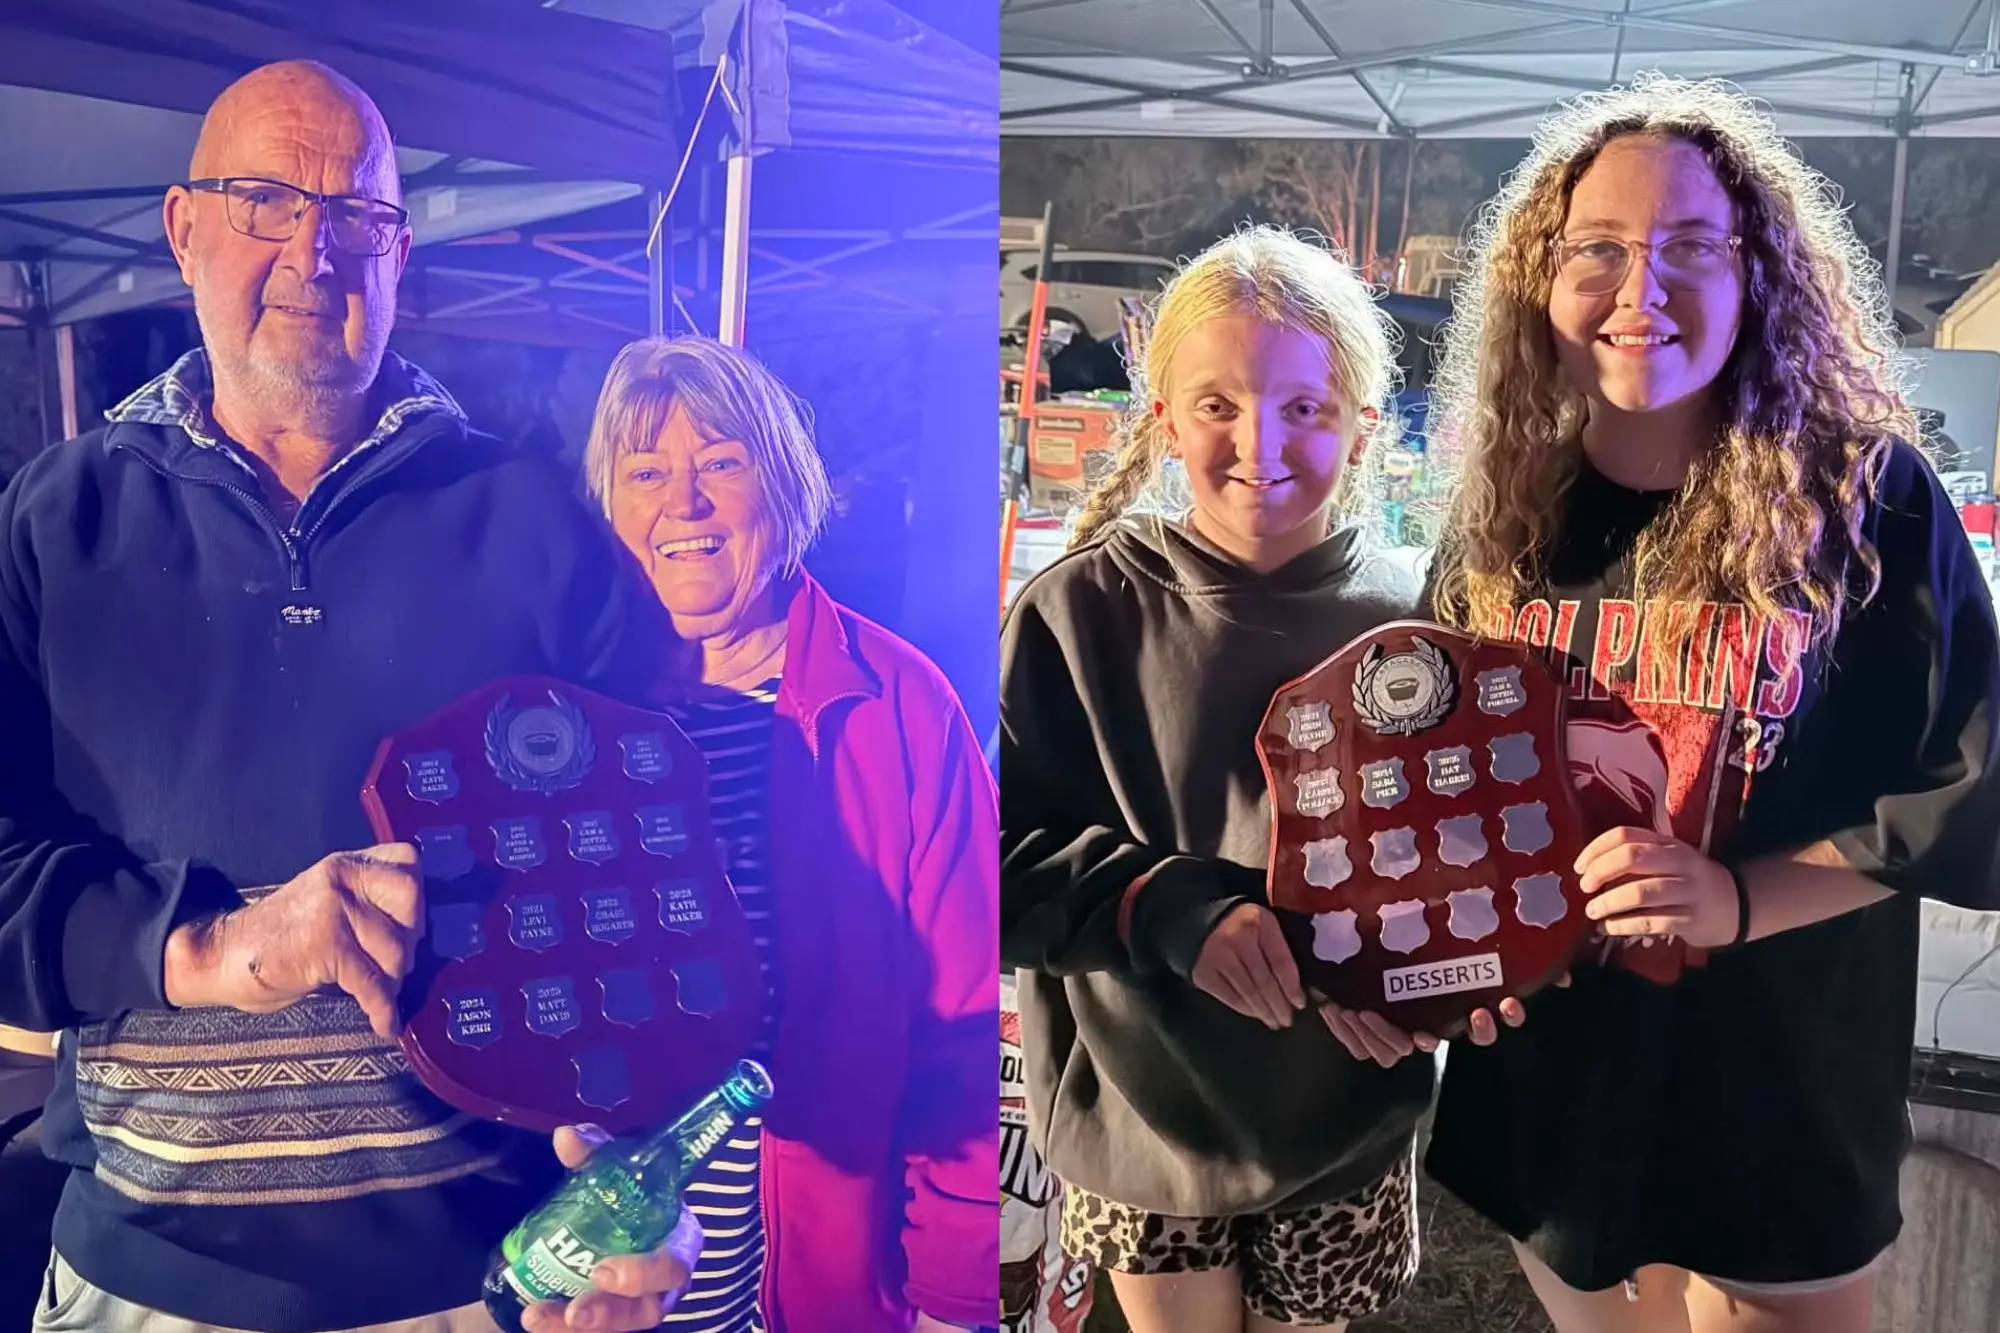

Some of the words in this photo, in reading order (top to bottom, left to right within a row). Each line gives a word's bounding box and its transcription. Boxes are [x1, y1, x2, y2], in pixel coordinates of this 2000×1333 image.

[1728, 717, 1785, 772] 23
[669, 900, 697, 911] KATH
[523, 916, 546, 926] LEVI
[668, 911, 703, 923] BAKER
[520, 927, 554, 939] PAYNE
[1388, 961, 1496, 994] DESSERTS
[457, 1009, 491, 1022] JASON
[461, 1023, 491, 1035] KERR
[688, 1110, 735, 1159] HAHN
[546, 1226, 597, 1277] HA
